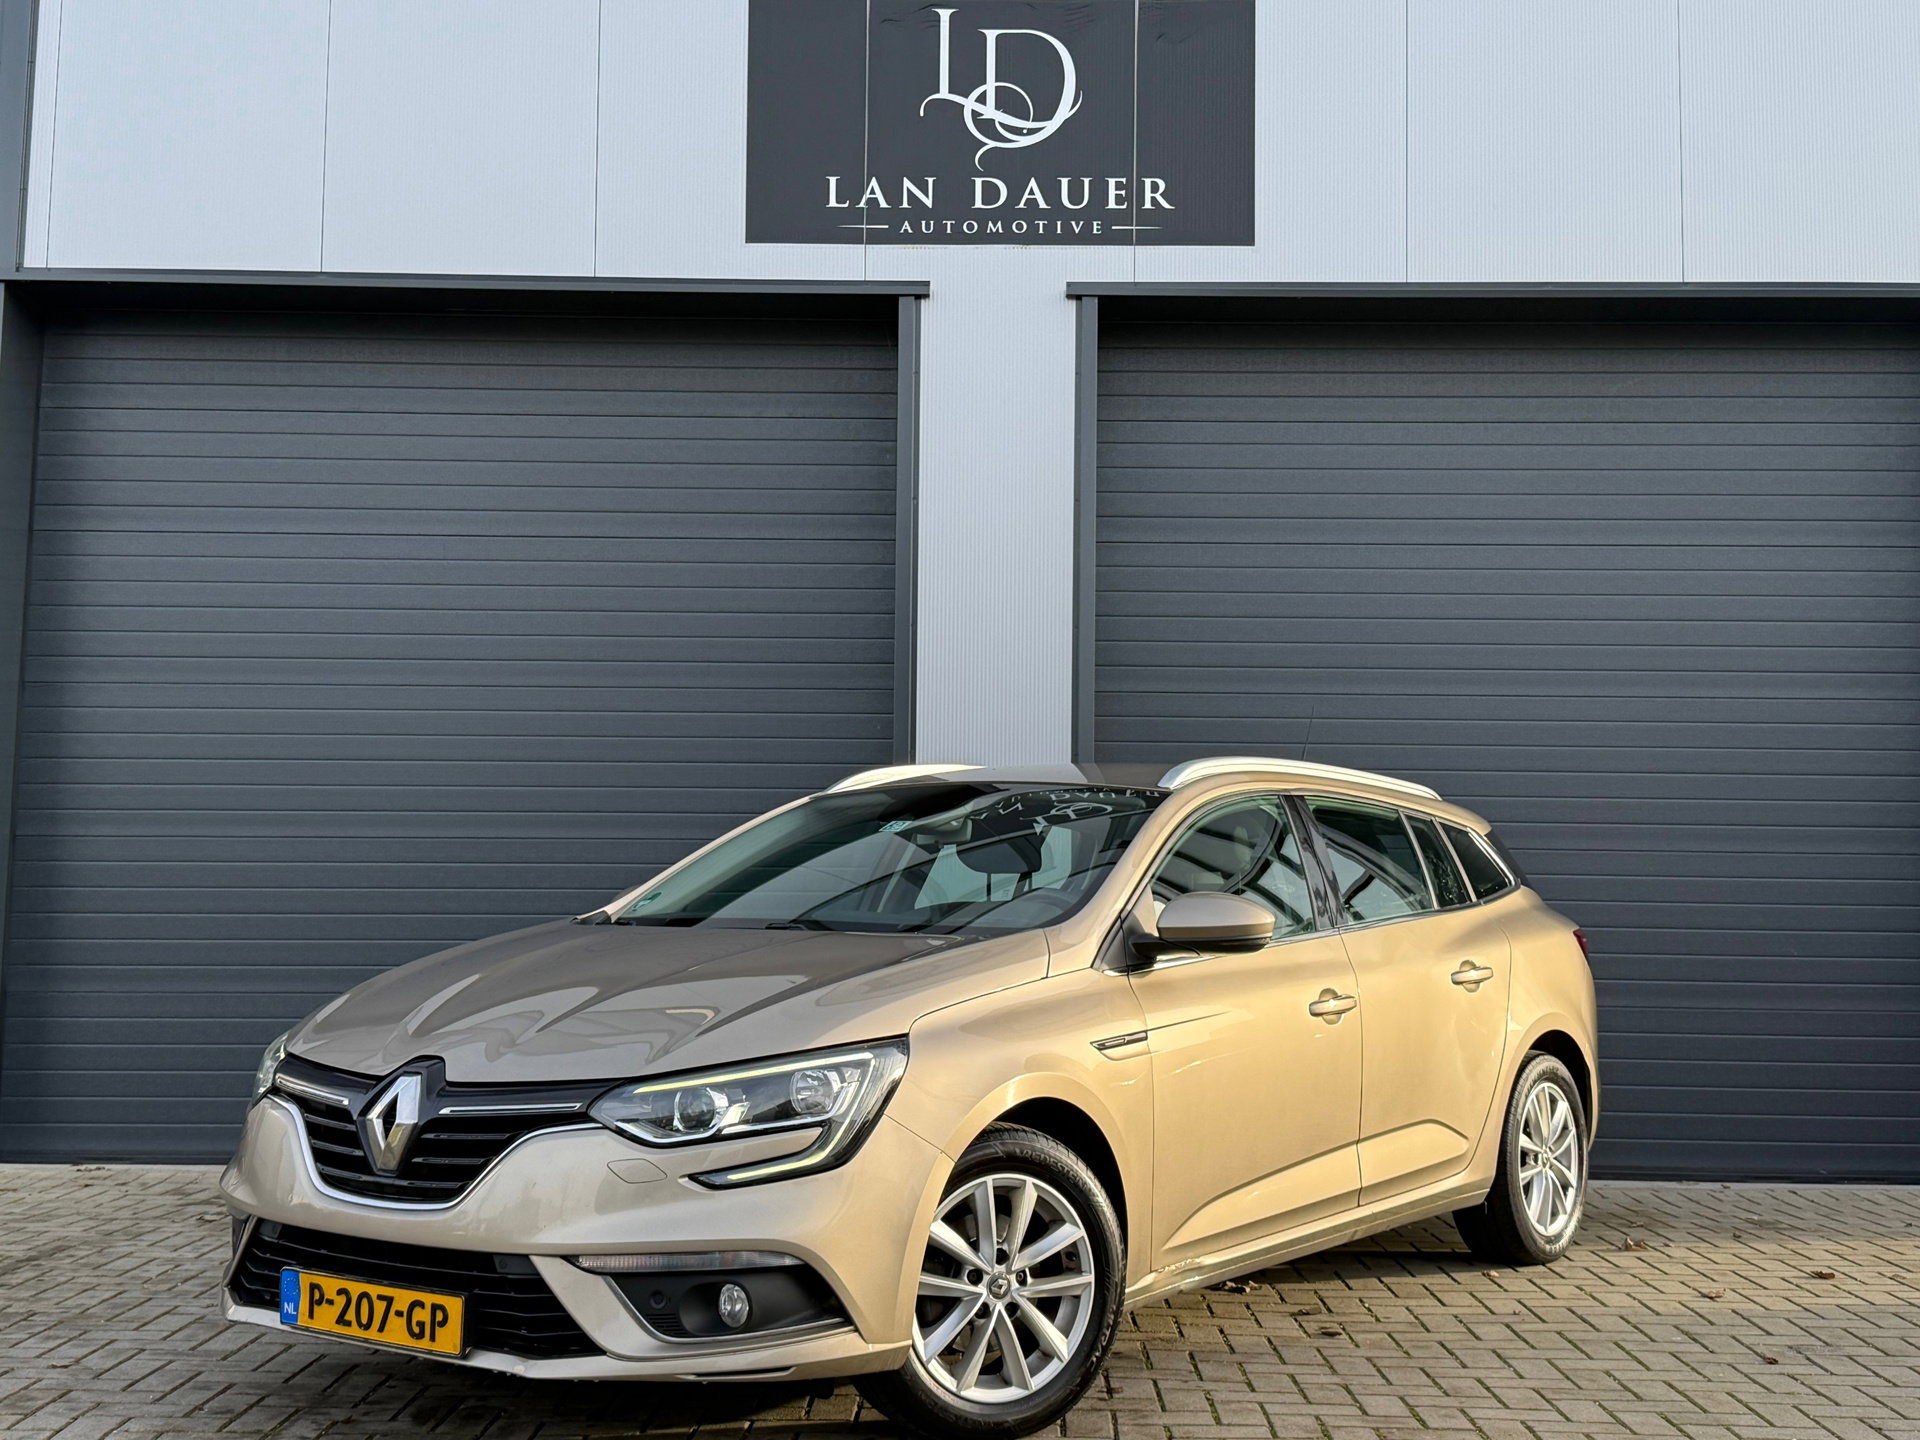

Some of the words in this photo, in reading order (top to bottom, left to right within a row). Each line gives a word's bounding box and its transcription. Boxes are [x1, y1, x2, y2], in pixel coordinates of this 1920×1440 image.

[826, 176, 937, 209] LAN
[971, 177, 1175, 209] DAUER
[900, 220, 1102, 234] AUTOMOTIVE
[283, 1301, 297, 1316] NL
[307, 1281, 450, 1344] P-207-GP
